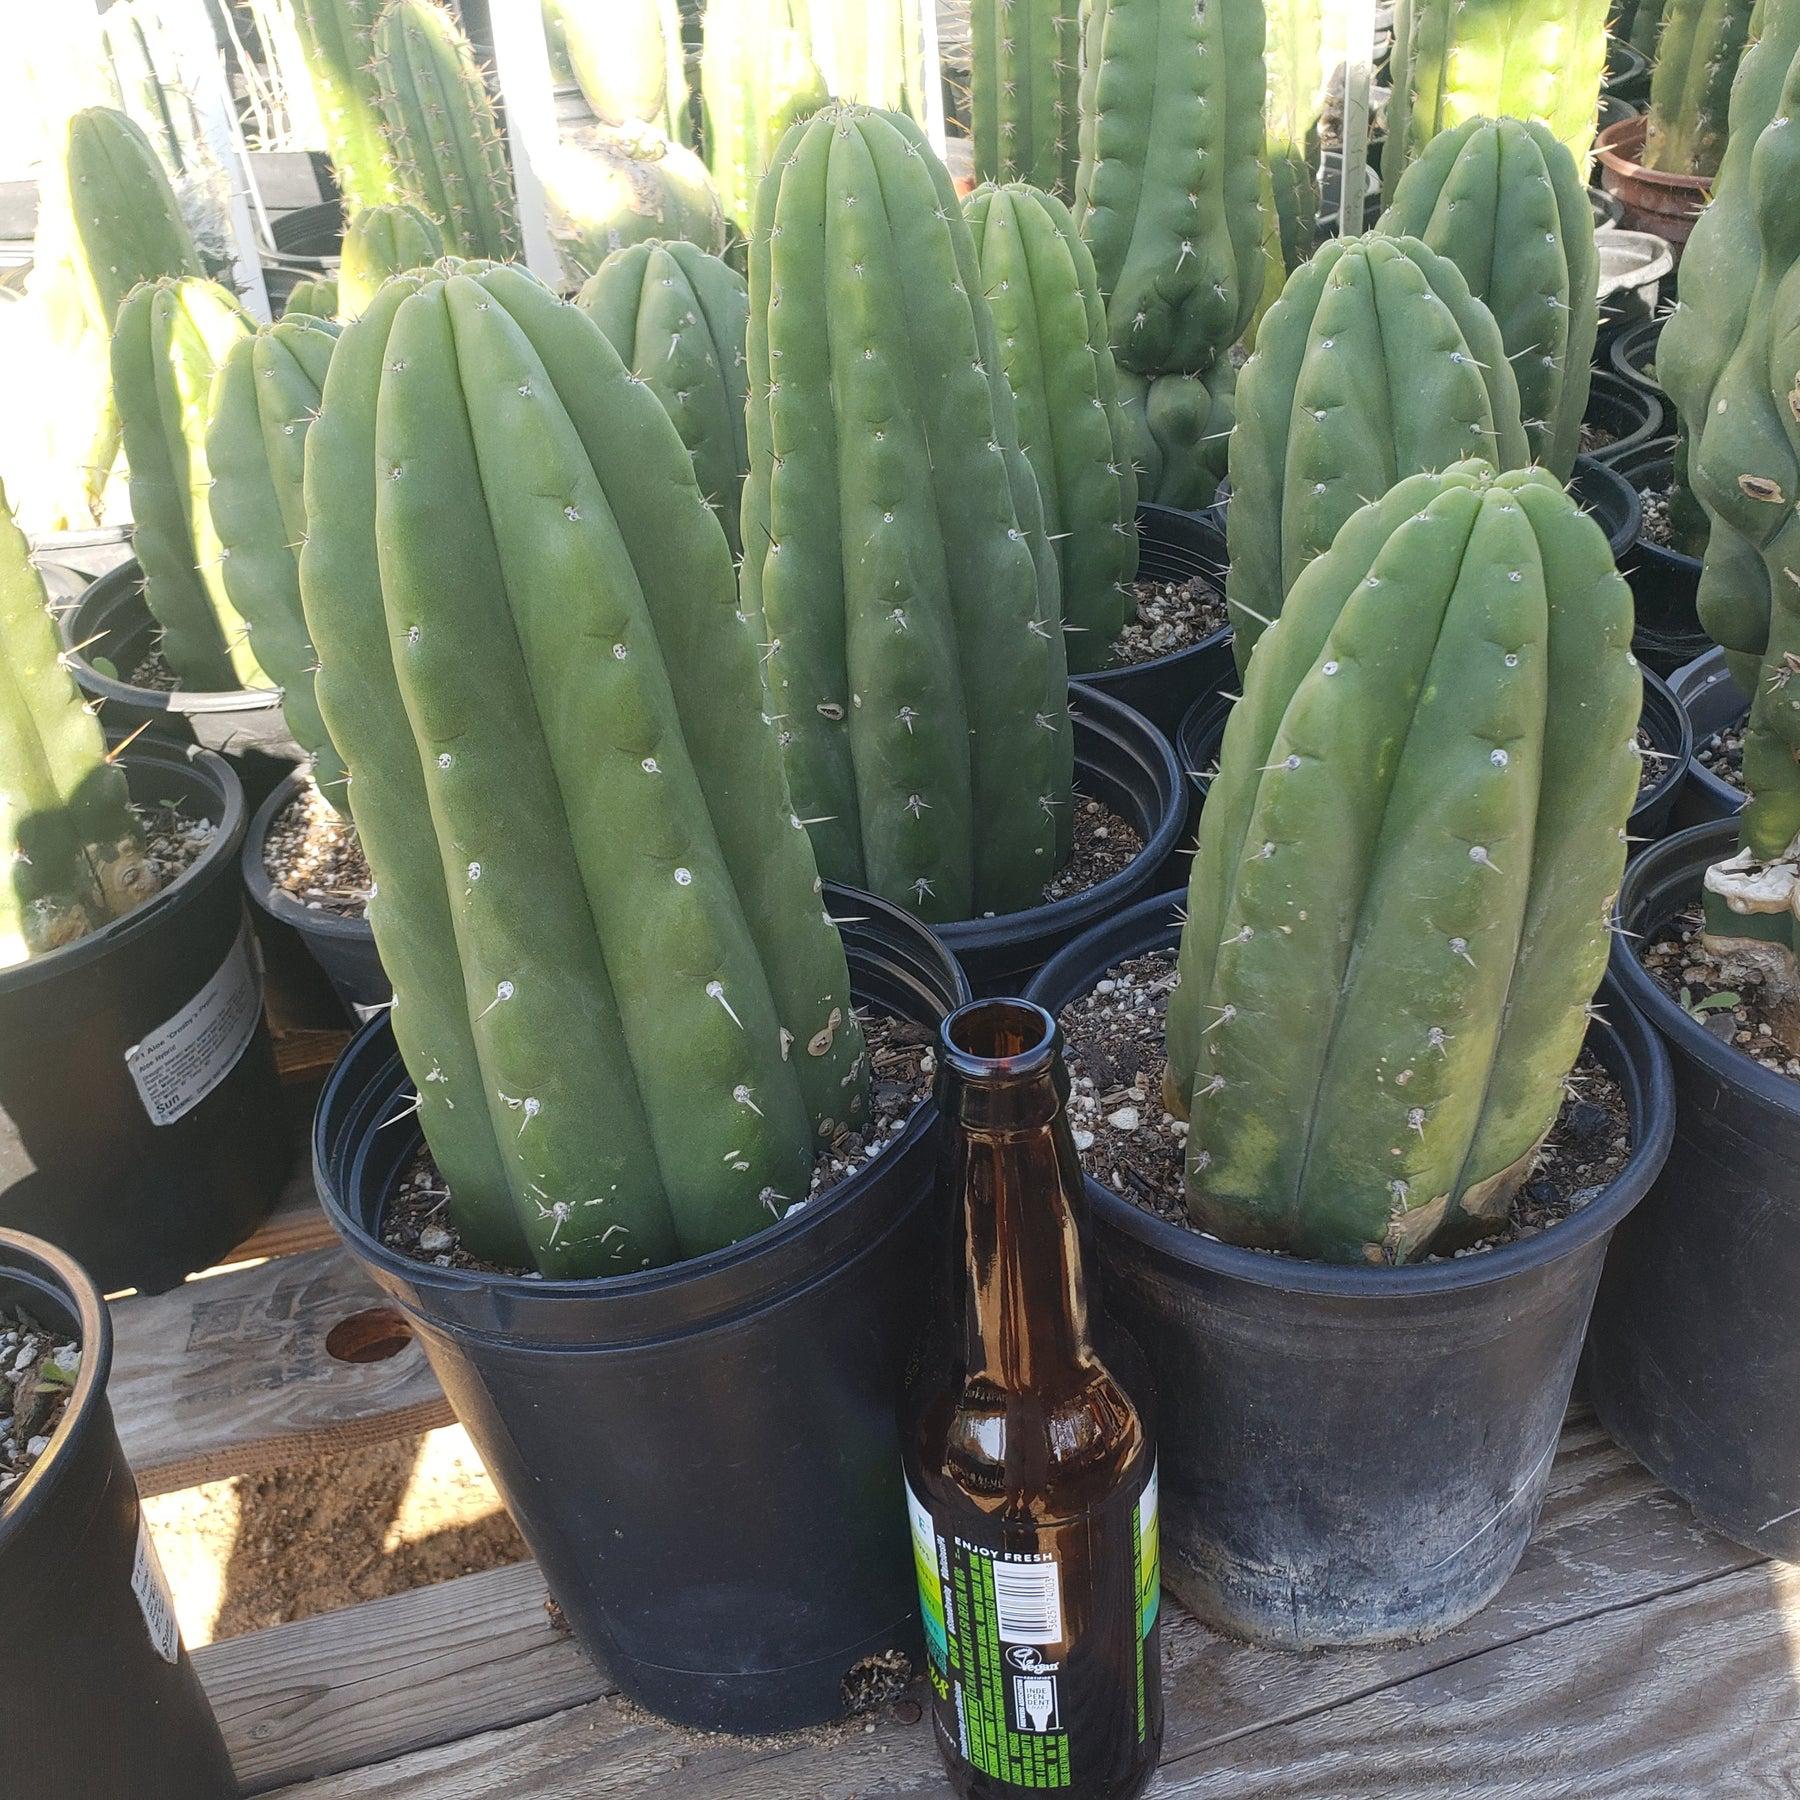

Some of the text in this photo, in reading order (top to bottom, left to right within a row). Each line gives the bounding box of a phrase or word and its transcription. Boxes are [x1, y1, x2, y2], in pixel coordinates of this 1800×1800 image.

[147, 1040, 166, 1055] Aloe
[139, 1044, 177, 1073] Aloe Hybrid
[156, 1094, 180, 1115] Sun
[954, 1536, 998, 1559] ENJOY
[1004, 1552, 1053, 1562] FRESH
[1016, 1660, 1059, 1675] Vegan
